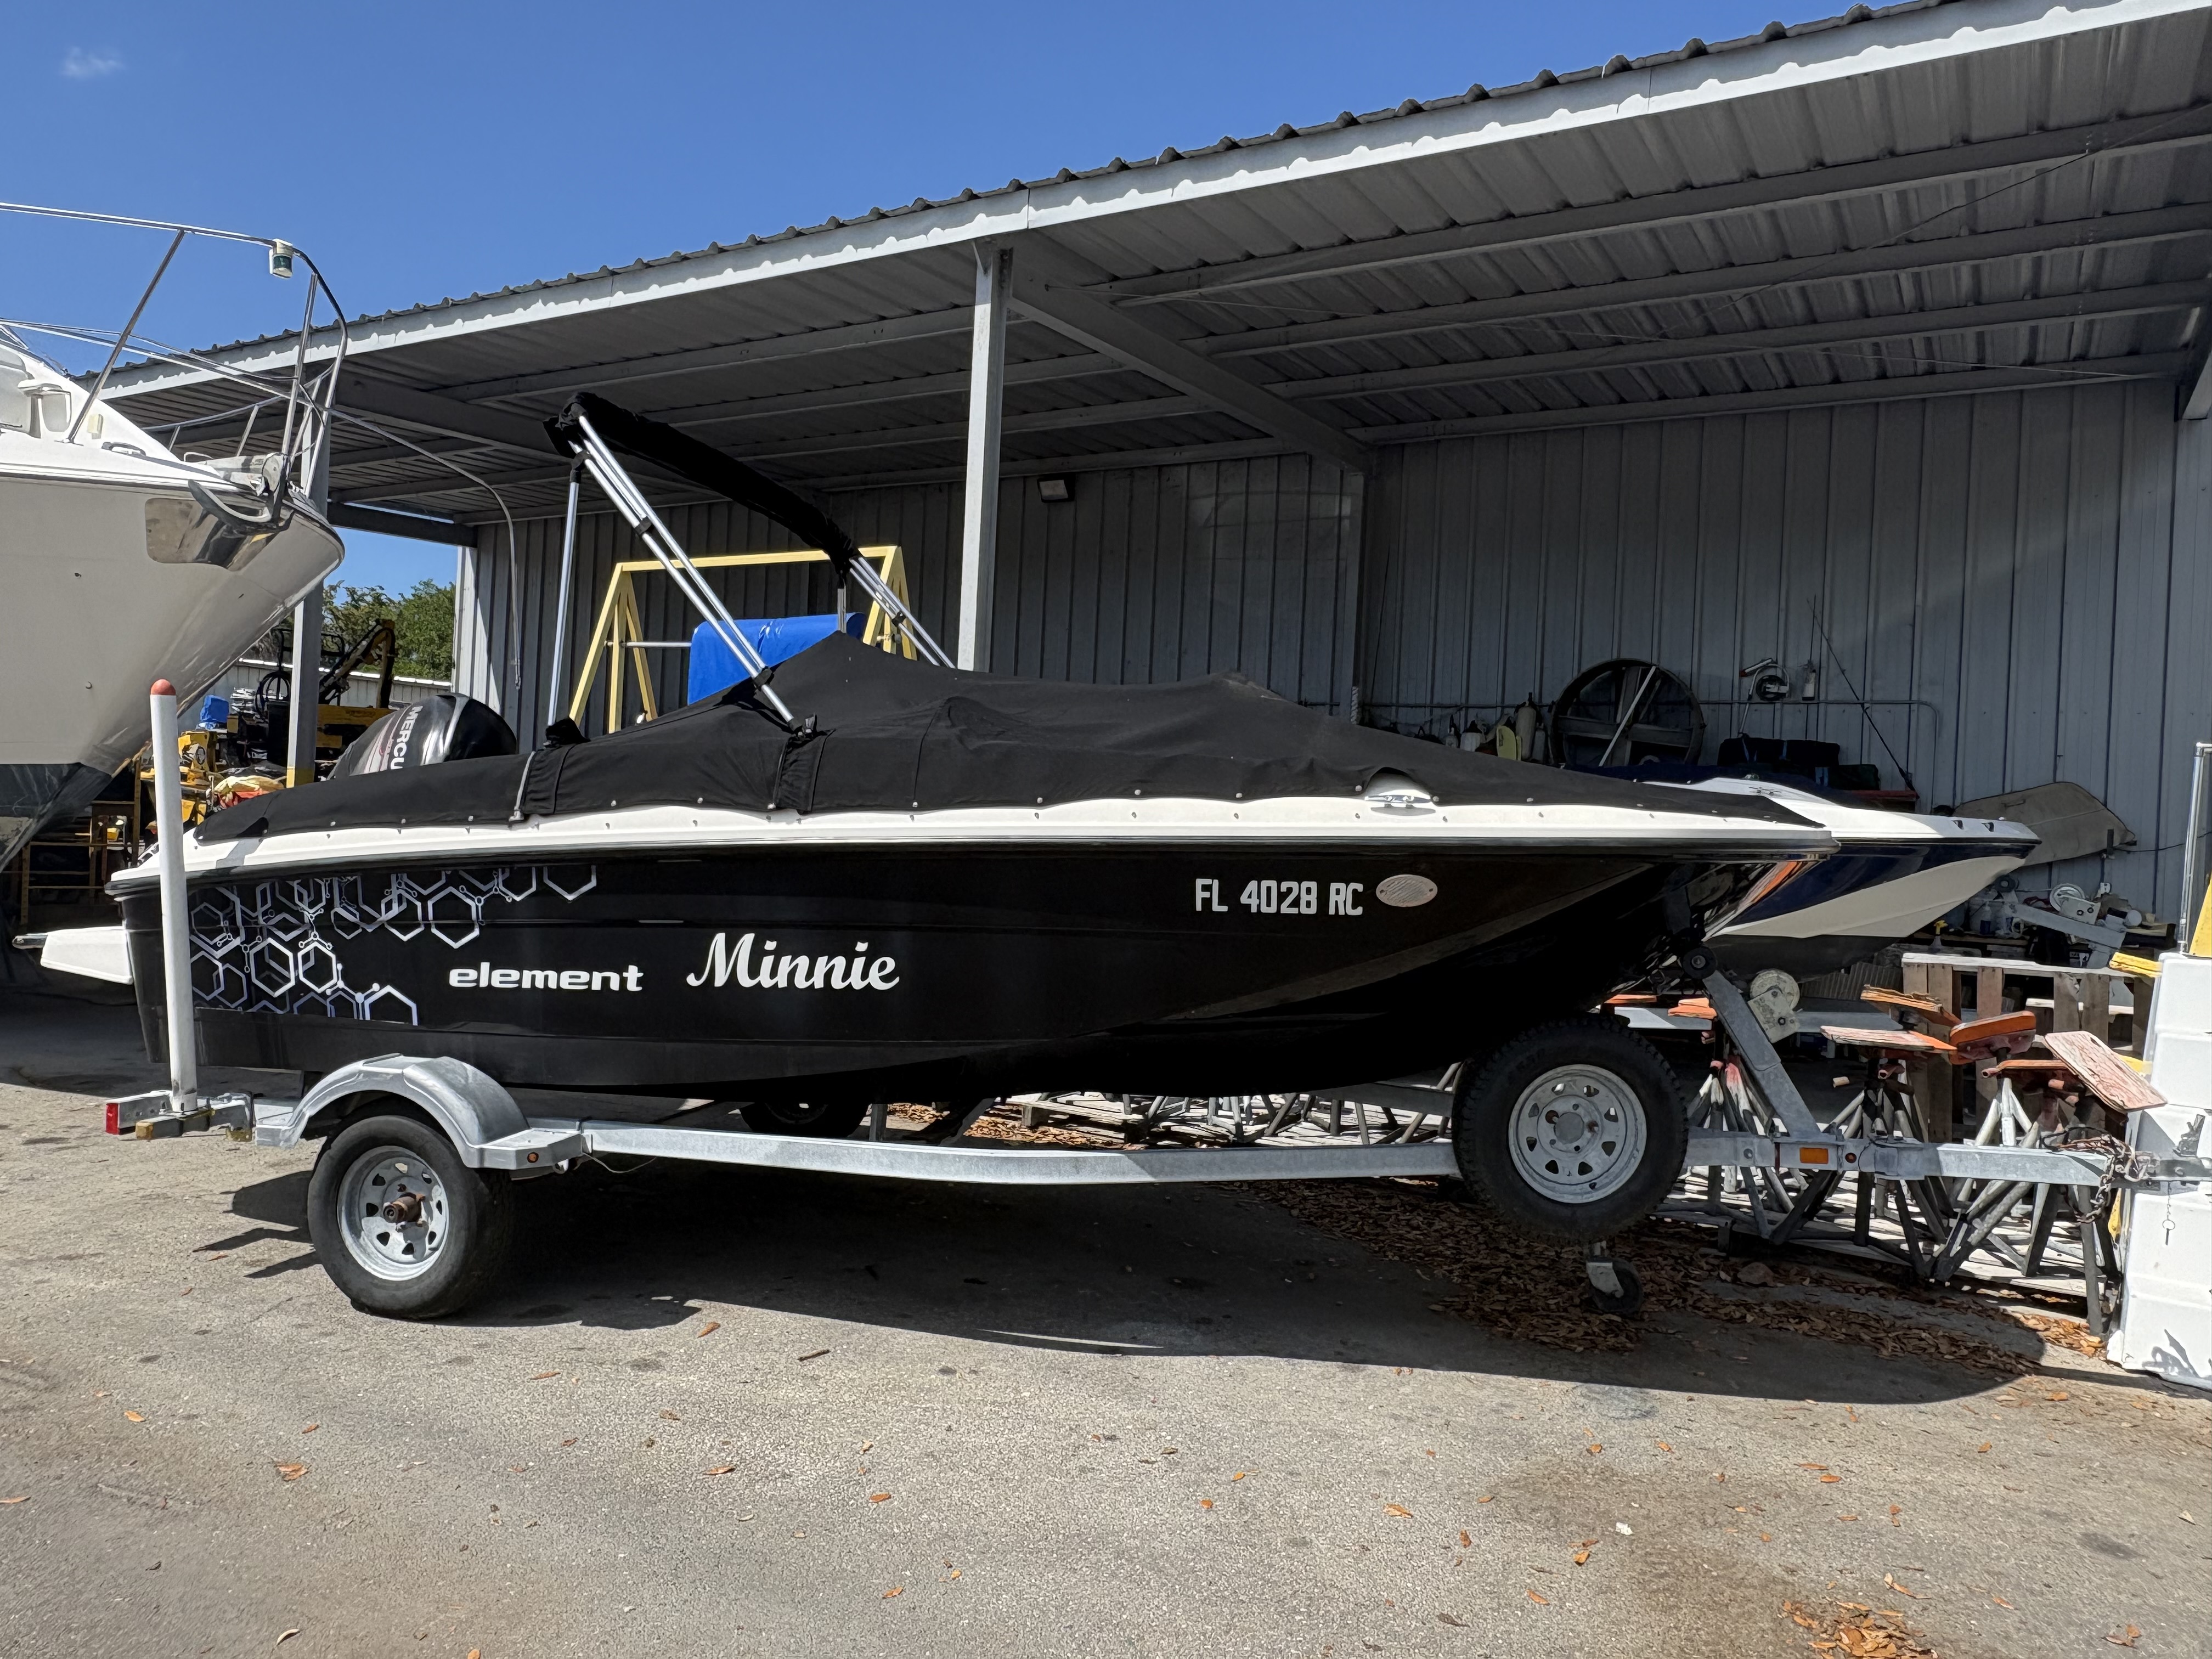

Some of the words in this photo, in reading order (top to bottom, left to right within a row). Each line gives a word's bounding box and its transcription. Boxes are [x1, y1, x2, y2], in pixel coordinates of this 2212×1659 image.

[390, 706, 424, 770] MERCU
[1196, 878, 1228, 911] FL
[1240, 880, 1317, 914] 4028
[1329, 883, 1363, 915] RC
[449, 962, 644, 991] element
[686, 933, 899, 990] Minnie
